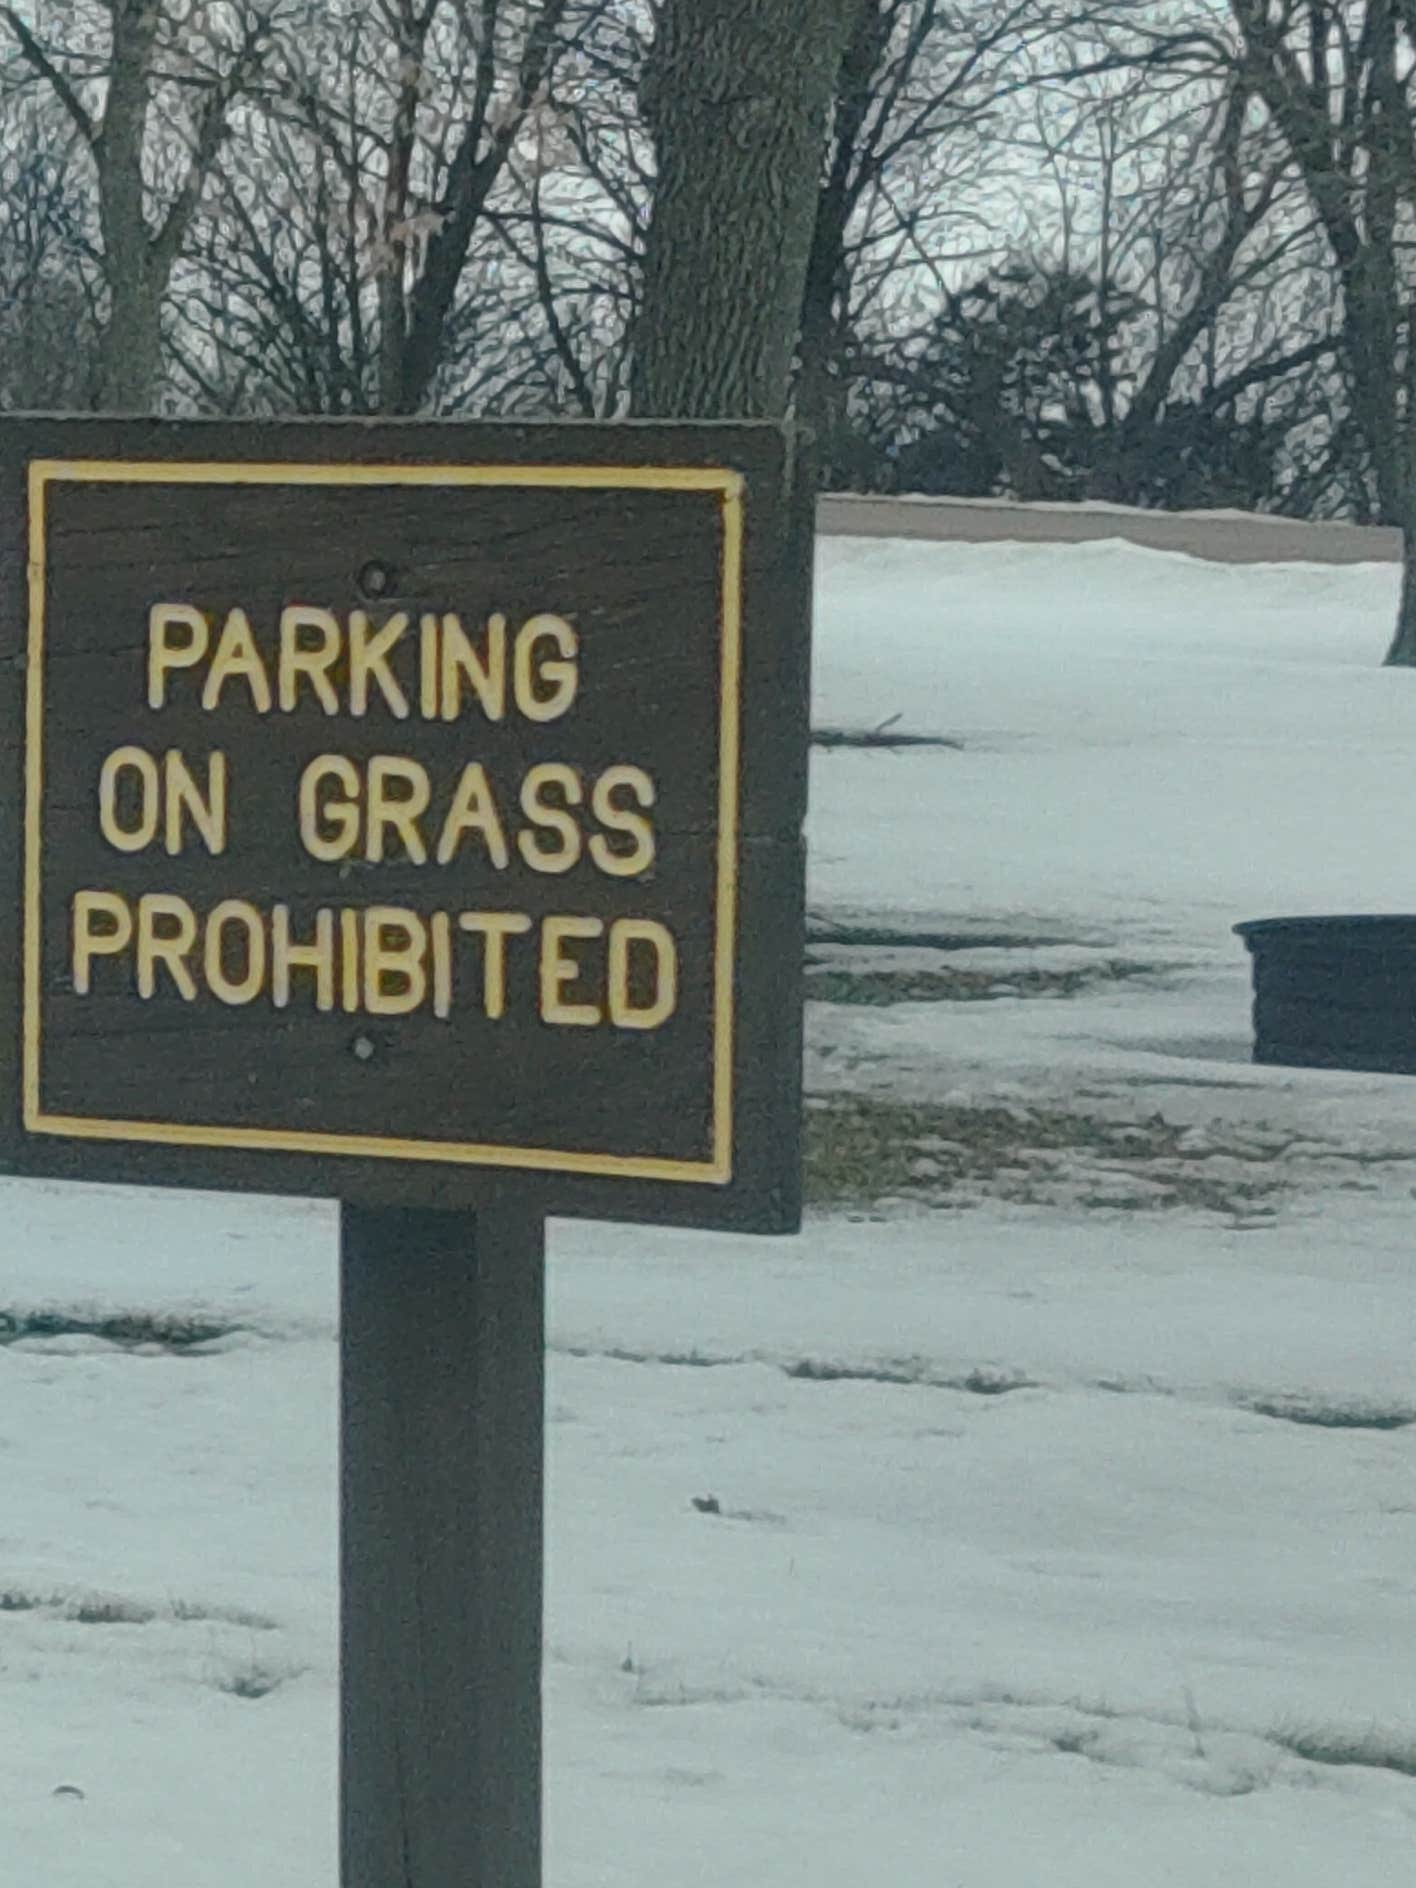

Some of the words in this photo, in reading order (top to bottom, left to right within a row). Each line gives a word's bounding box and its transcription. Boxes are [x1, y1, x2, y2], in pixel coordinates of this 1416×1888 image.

[147, 602, 579, 723] PARKING
[98, 745, 226, 856] ON
[298, 753, 656, 877] GRASS
[72, 889, 677, 1030] PROHIBITED
